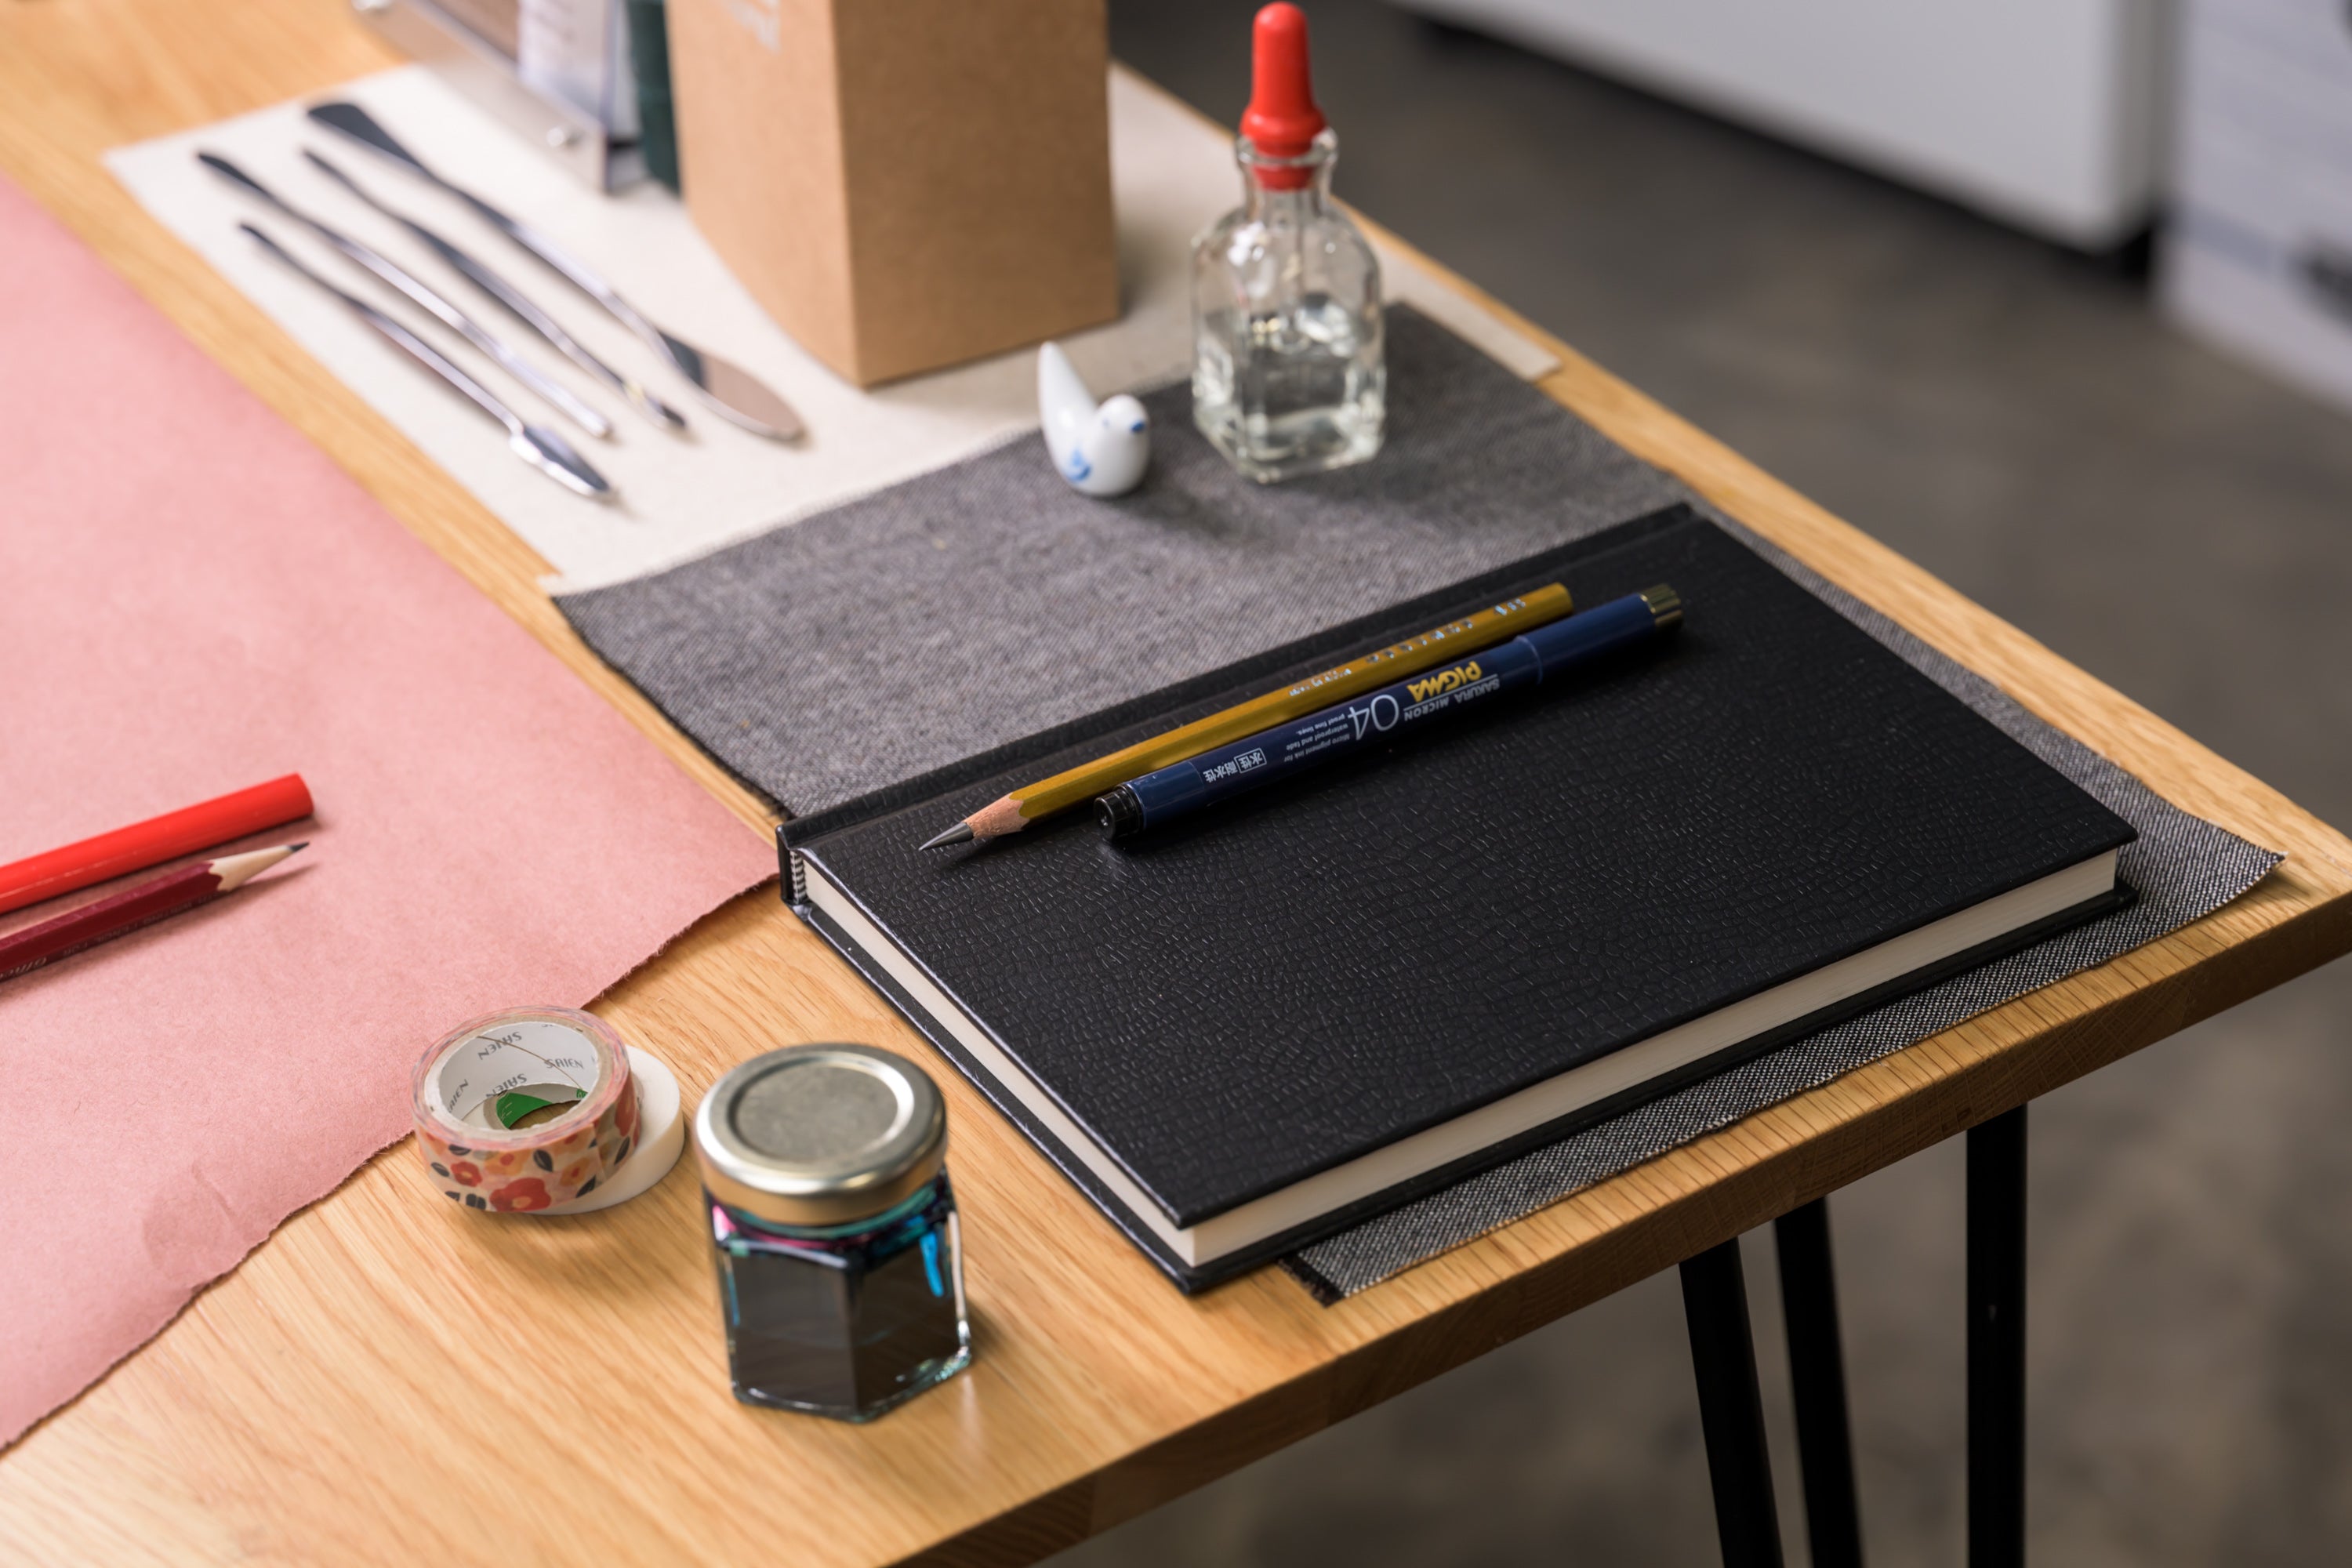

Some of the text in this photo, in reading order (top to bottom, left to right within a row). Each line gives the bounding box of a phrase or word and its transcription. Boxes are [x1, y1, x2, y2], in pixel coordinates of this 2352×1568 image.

[1406, 660, 1482, 702] PIGMA
[1403, 677, 1500, 721] SAKURA MICRON
[1315, 720, 1327, 729] fine
[1328, 713, 1345, 726] proof
[1348, 694, 1399, 741] 04
[1283, 733, 1350, 762] Micro pigment ink for
[1286, 723, 1348, 750] waterproof and fade
[1203, 752, 1263, 782] 水性 耐水性
[477, 1032, 523, 1061] SAIEN
[544, 1058, 586, 1070] SAIEN
